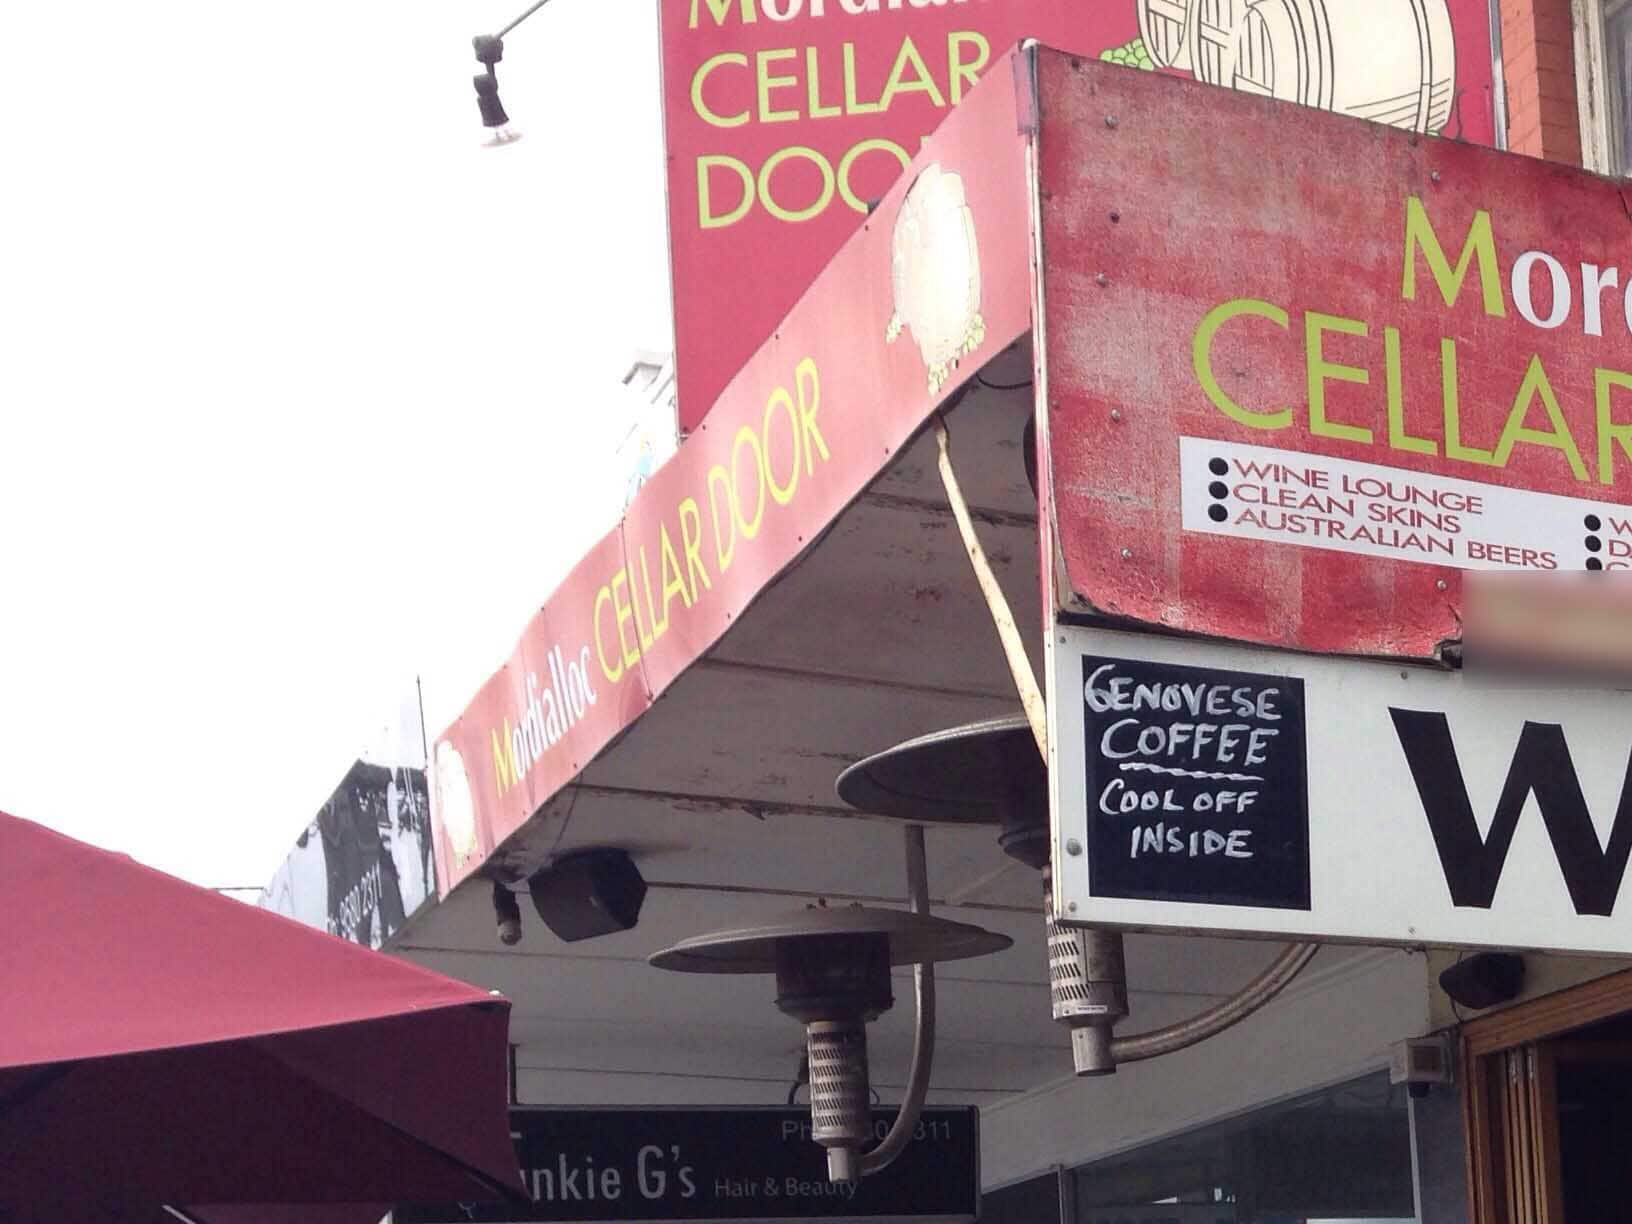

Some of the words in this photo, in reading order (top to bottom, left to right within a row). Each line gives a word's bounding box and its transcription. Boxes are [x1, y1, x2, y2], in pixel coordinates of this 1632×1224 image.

[691, 31, 990, 128] CELLAR
[697, 136, 932, 229] DOO
[1232, 458, 1329, 489] WINE
[1342, 474, 1483, 514] LOUNGE
[1233, 484, 1354, 519] CLEAN
[1367, 503, 1462, 534] SKINS
[1234, 508, 1454, 556] AUSTRALIAN
[1467, 541, 1558, 570] BEERS
[490, 644, 598, 799] Mordialloc
[592, 497, 713, 684] CELLAR
[707, 356, 831, 573] DOOR
[1084, 664, 1282, 720] GENOVESE
[1100, 718, 1280, 766] COFFEE
[1099, 778, 1185, 815] COOL
[1192, 791, 1259, 814] OFF
[1130, 822, 1254, 858] INSIDE
[636, 1144, 697, 1199] G's
[714, 1178, 758, 1198] Hair
[764, 1178, 780, 1197] &
[785, 1177, 857, 1202] Beauty
